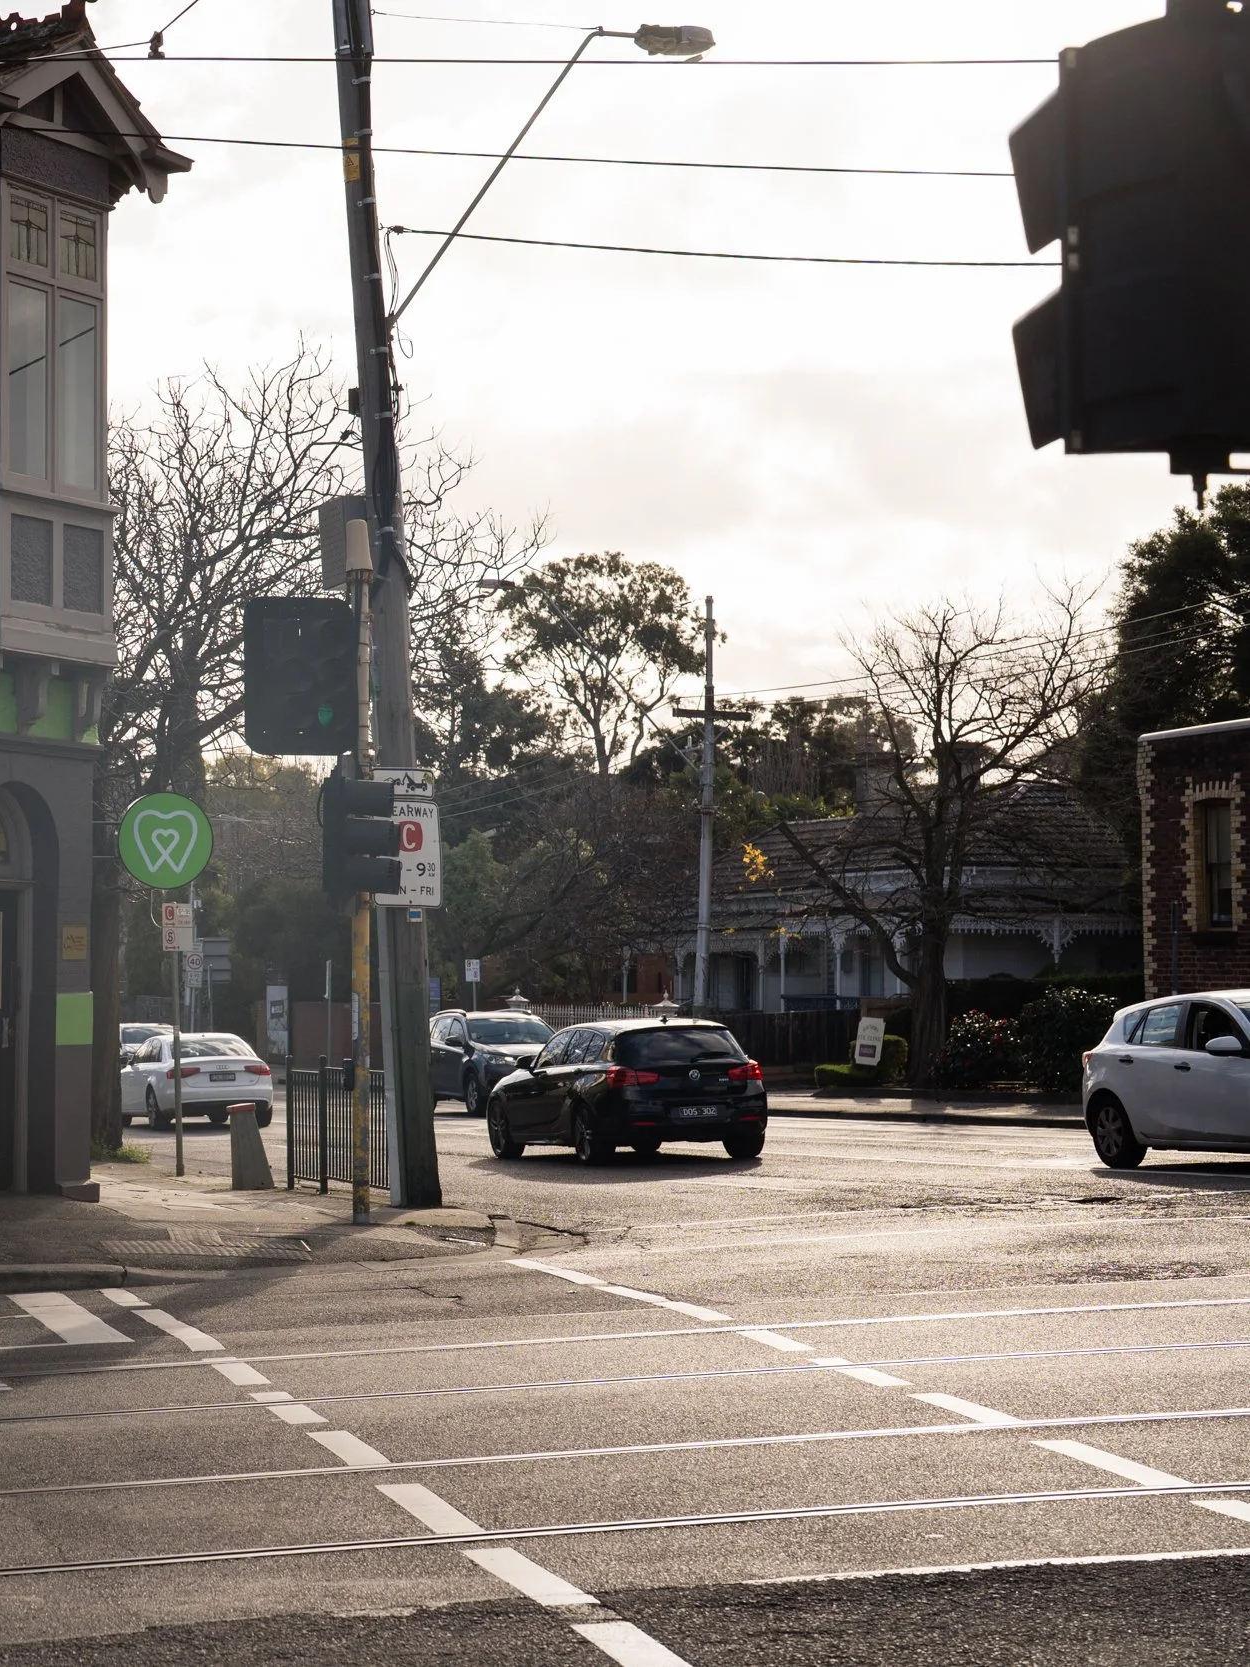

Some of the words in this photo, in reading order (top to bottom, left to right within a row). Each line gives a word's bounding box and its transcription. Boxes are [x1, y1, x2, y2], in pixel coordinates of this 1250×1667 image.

[392, 805, 434, 818] EARWAY
[402, 823, 416, 849] C
[420, 886, 434, 897] FRI
[189, 958, 201, 966] 40
